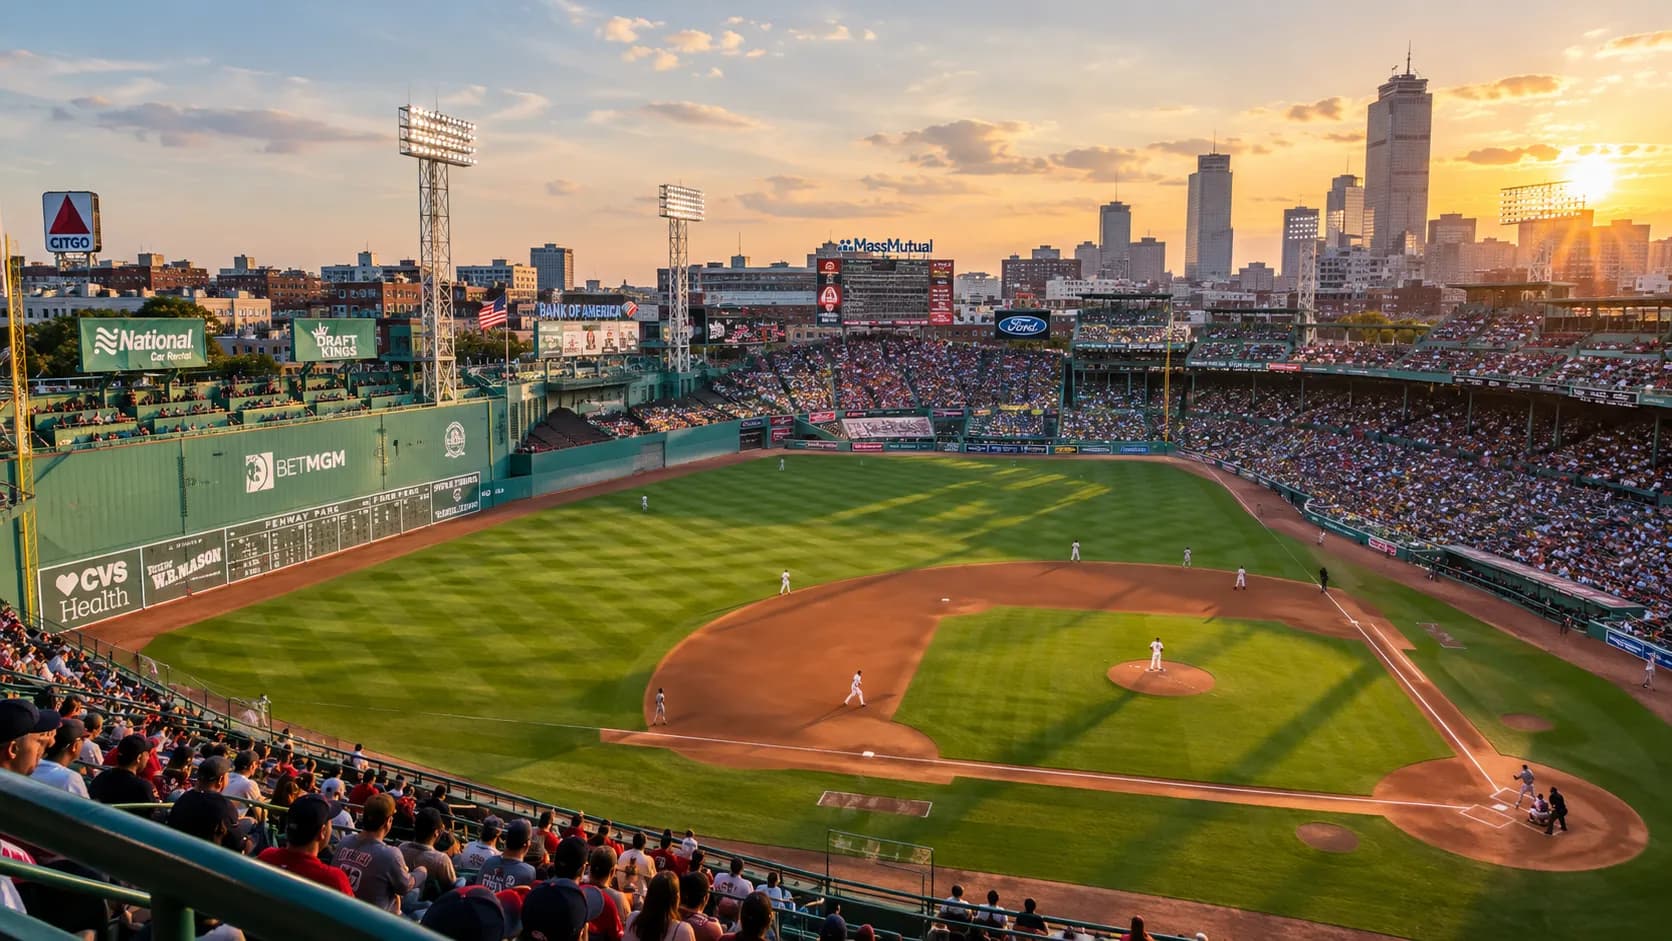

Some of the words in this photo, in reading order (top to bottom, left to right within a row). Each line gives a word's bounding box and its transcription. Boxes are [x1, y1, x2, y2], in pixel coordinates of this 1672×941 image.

[50, 237, 90, 249] CITGO
[854, 238, 933, 253] MassMutual
[540, 302, 567, 318] BANK
[568, 304, 581, 318] OF
[582, 304, 621, 318] AMERICA
[1007, 318, 1038, 332] Ford
[119, 328, 193, 351] National
[317, 334, 358, 347] DRAFT
[151, 352, 164, 361] Car
[167, 351, 192, 361] Rental
[321, 346, 358, 358] KINGS
[276, 450, 346, 478] BETMGM
[80, 560, 128, 592] CVS
[59, 587, 130, 624] Health
